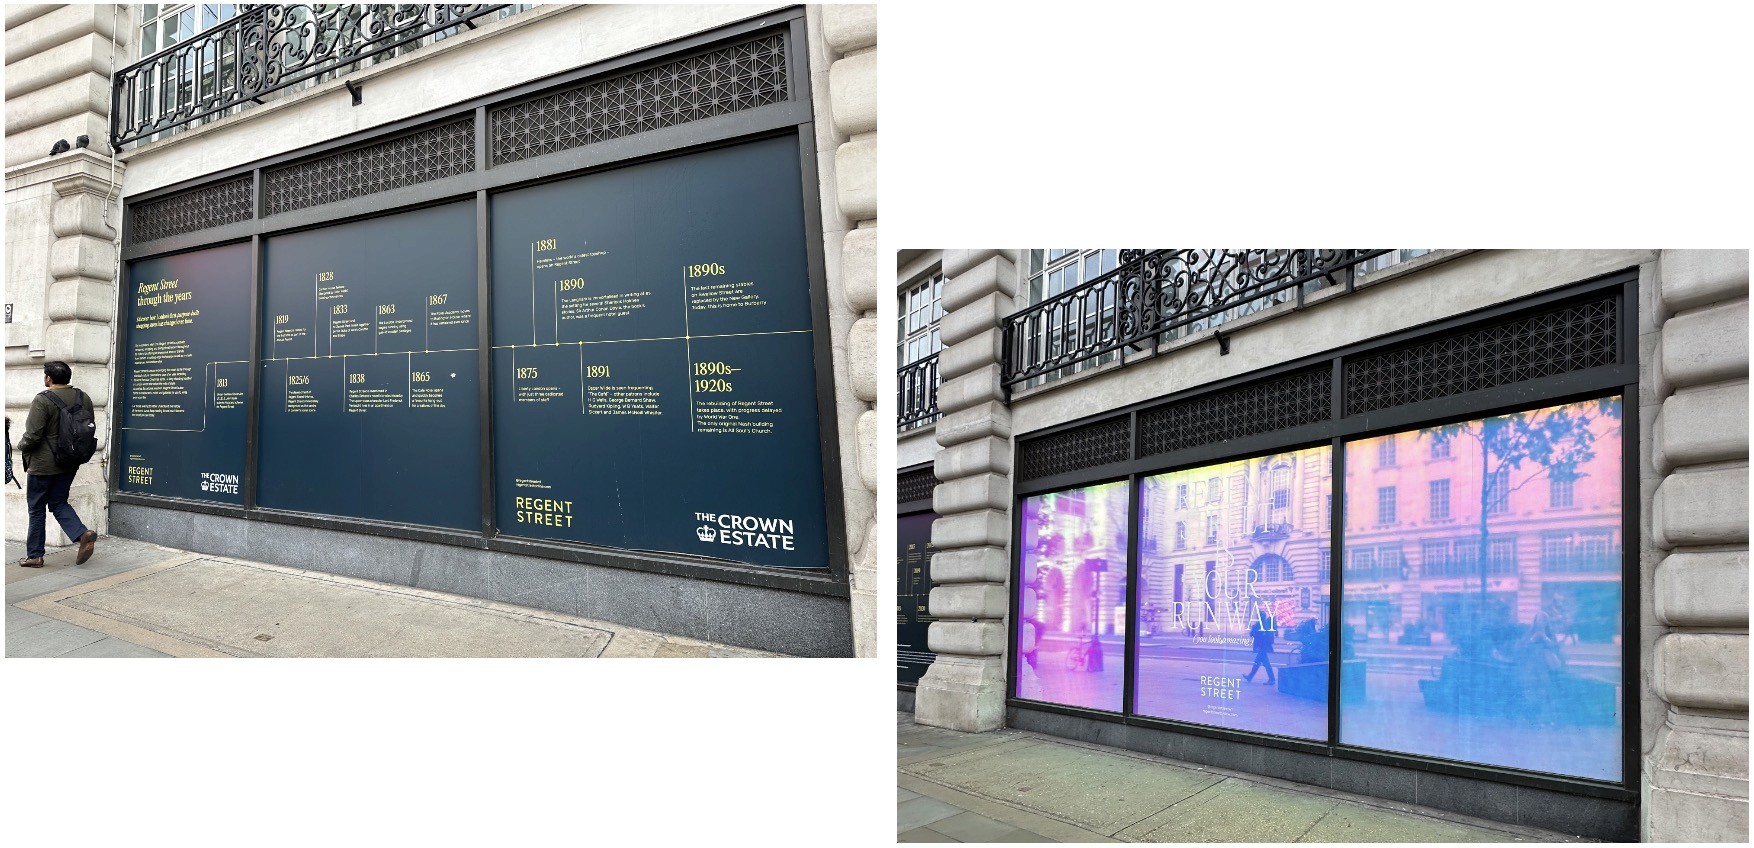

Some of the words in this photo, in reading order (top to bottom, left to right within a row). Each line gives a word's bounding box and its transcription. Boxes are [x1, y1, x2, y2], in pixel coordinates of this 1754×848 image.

[536, 239, 557, 251] 1881
[688, 262, 725, 278] 1890s
[319, 272, 334, 281] 1828
[138, 283, 159, 295] Regent
[160, 279, 179, 290] Street
[560, 278, 585, 291] 1890
[138, 293, 162, 307] through
[163, 292, 173, 303] the
[174, 292, 192, 304] years
[429, 294, 447, 305] 1867
[333, 304, 348, 315] 1833
[379, 304, 395, 315] 1863
[276, 315, 289, 324] 1819
[412, 372, 430, 382] 1865
[517, 368, 538, 379] 1875
[587, 365, 610, 378] 1891
[349, 373, 365, 384] 1838
[695, 379, 732, 392] 1920s
[129, 466, 153, 475] REGENT
[128, 475, 153, 485] STREET
[209, 473, 239, 484] CROWN
[209, 483, 238, 494] ESTATE
[516, 496, 572, 513] REGENT
[517, 510, 573, 528] STREET
[695, 512, 716, 522] THE
[718, 514, 793, 535] CROWN
[720, 530, 795, 551] ESTATE
[1171, 601, 1278, 632] RUNWAY
[1200, 676, 1241, 688] REGENT
[1201, 687, 1241, 700] STREET
